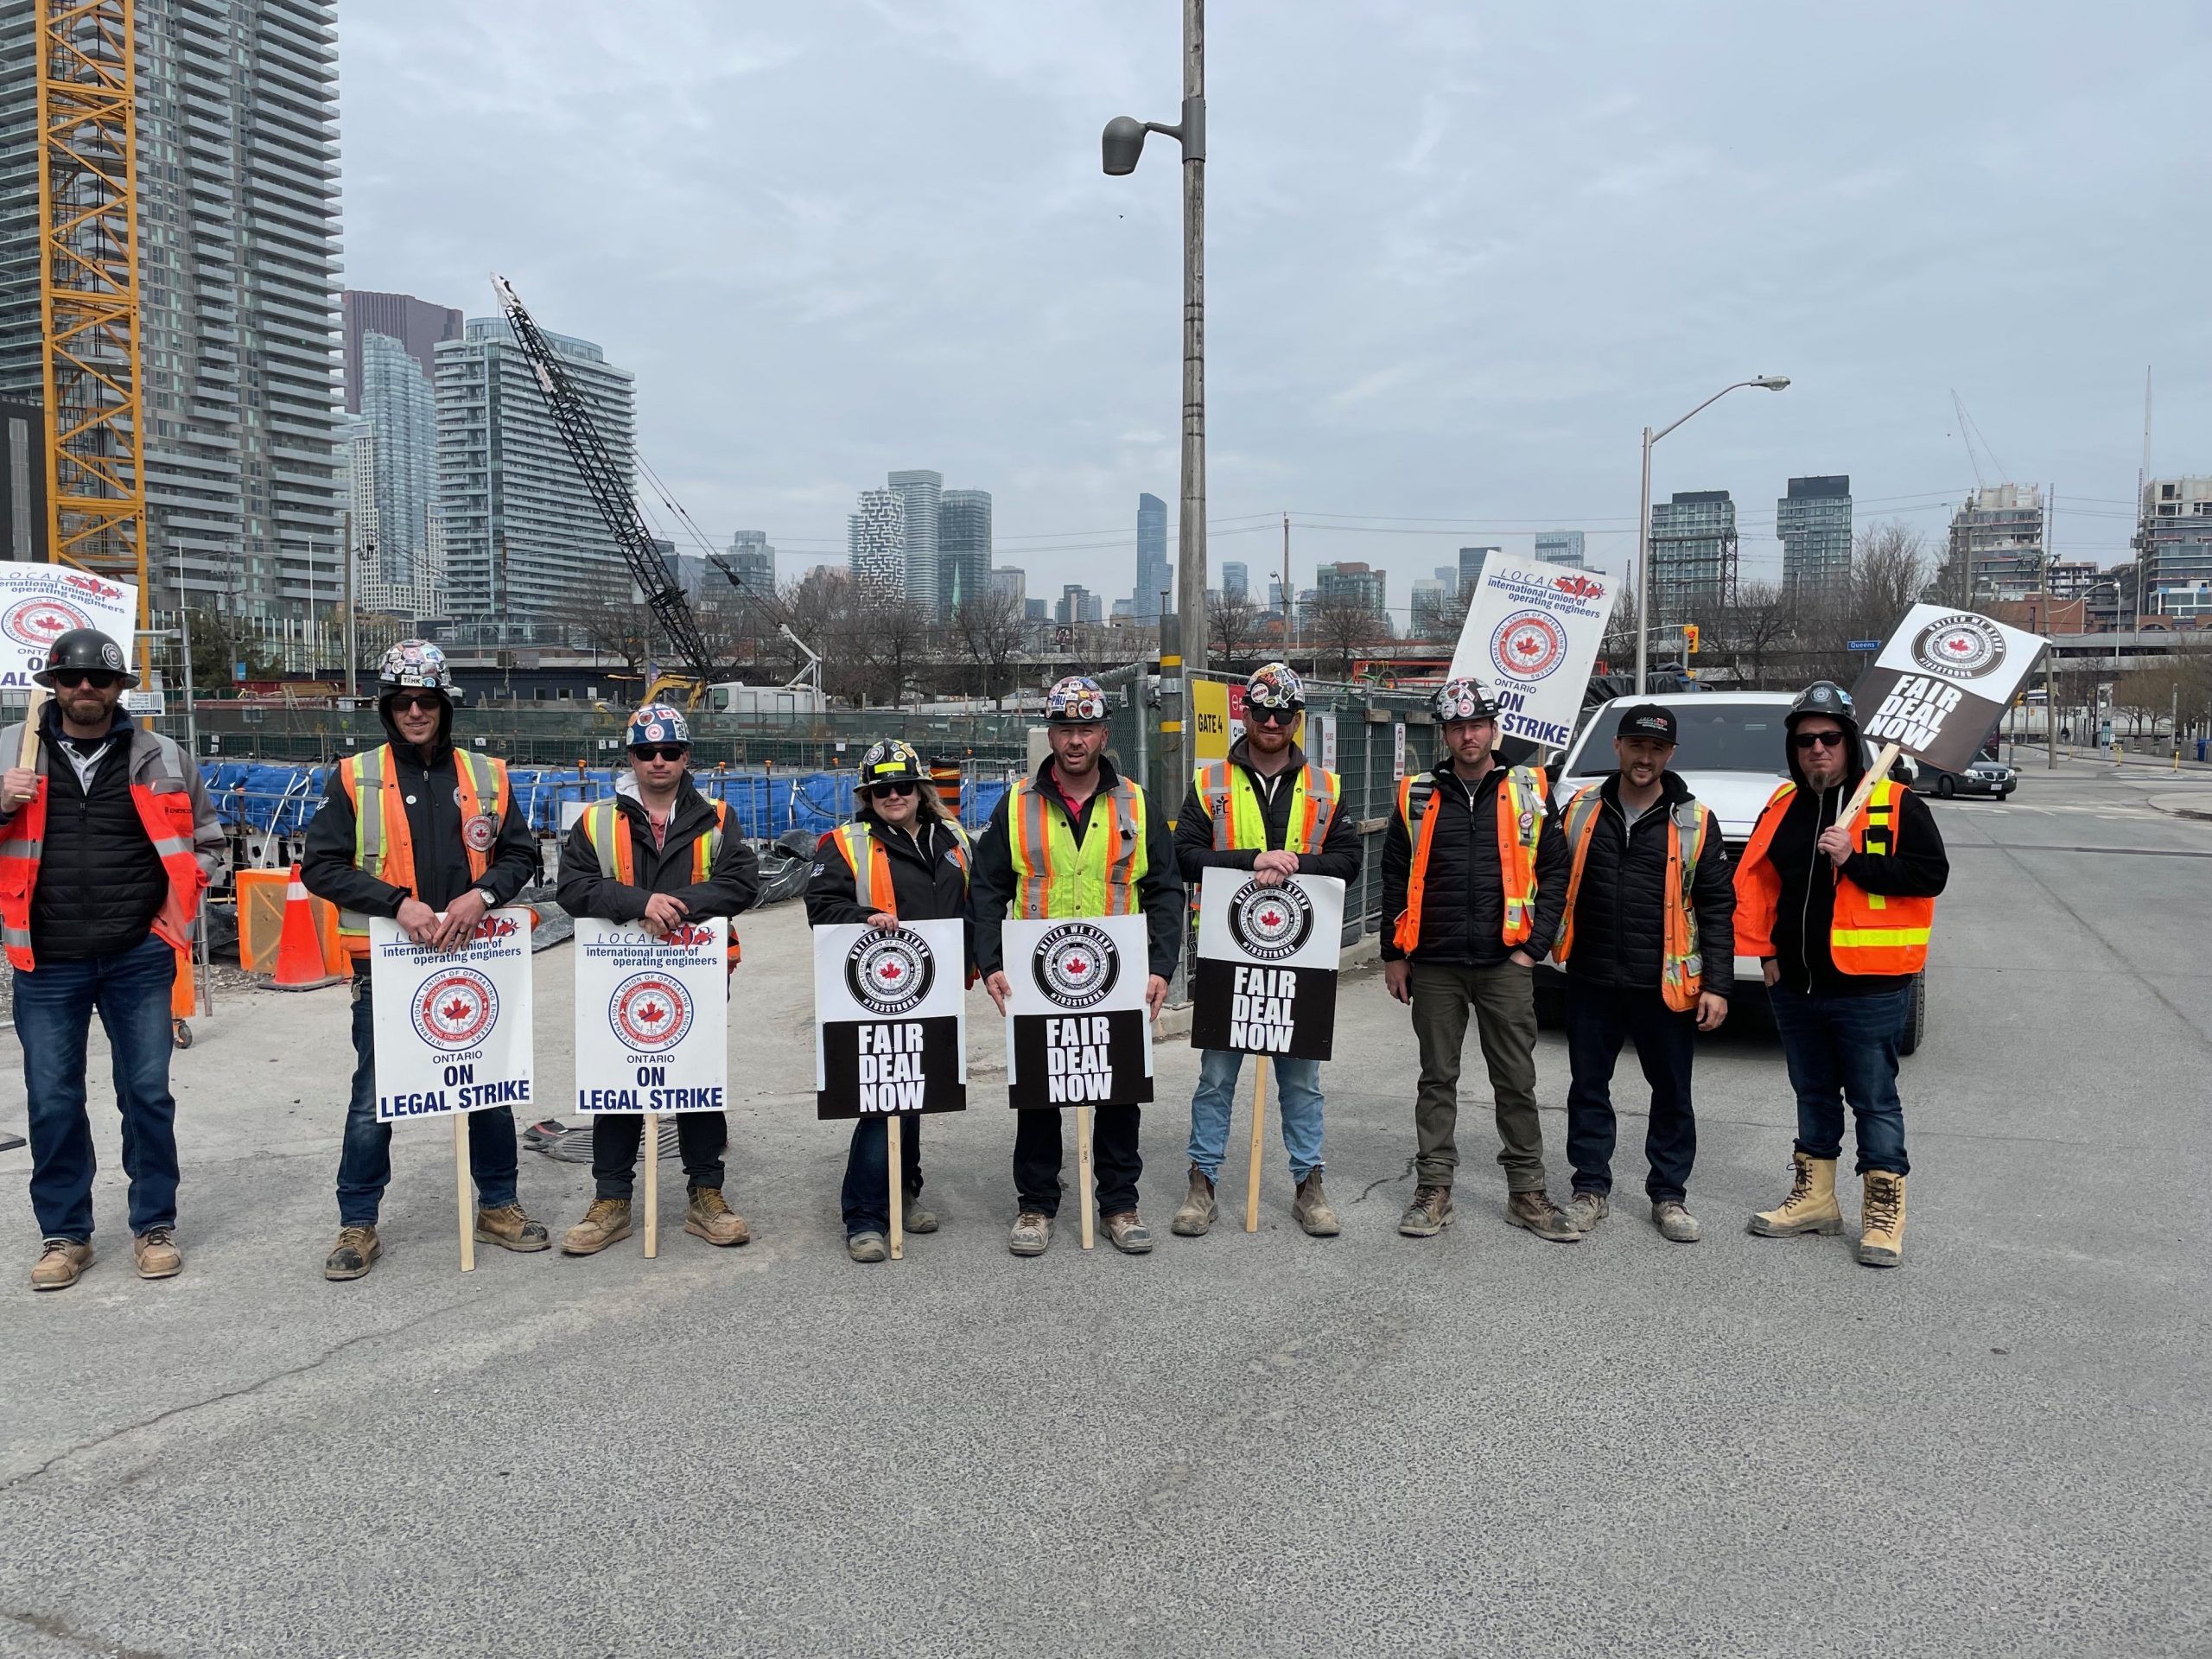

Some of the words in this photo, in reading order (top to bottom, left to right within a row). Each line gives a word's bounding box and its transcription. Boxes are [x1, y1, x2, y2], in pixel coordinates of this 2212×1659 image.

[0, 579, 58, 592] ernational
[60, 585, 92, 597] union
[1500, 569, 1554, 588] LOCAL
[11, 587, 68, 599] operating
[71, 594, 125, 614] engineers
[1488, 578, 1547, 598] international
[1548, 593, 1575, 605] union
[1576, 598, 1587, 607] of
[1509, 593, 1553, 609] operating
[1554, 602, 1600, 619] engineers
[1928, 616, 1966, 632] UNITED
[1971, 616, 1986, 626] WE
[1493, 625, 1509, 673] INTERNATIONAL
[1508, 613, 1529, 624] UNION
[1542, 615, 1565, 650] OPERATING
[1918, 657, 1972, 677] #793STRONG
[1494, 678, 1537, 694] ONTARIO
[1890, 675, 1963, 713] FAIR
[1498, 690, 1525, 713] ON
[1877, 695, 1942, 734] DEAL
[1198, 714, 1217, 734] GATE
[1217, 715, 1223, 734] 4
[1502, 713, 1570, 746] STRIKE
[1863, 715, 1939, 753] NOW
[1211, 799, 1229, 816] GFL
[1234, 882, 1259, 905] UNITE
[1286, 884, 1310, 911] STAND
[1249, 891, 1267, 902] UNION
[492, 938, 502, 949] of
[597, 932, 658, 944] LOCAL
[849, 931, 881, 961] UNITED
[903, 932, 931, 958] STAND
[866, 942, 883, 956] UNION
[1036, 928, 1066, 956] UNITED
[1071, 925, 1084, 934] WE
[1088, 928, 1115, 953] STAND
[1052, 938, 1069, 952] UNION
[1080, 937, 1106, 961] OPERATING
[1242, 941, 1296, 958] #793STRONG
[413, 952, 468, 966] operating
[470, 947, 522, 962] engineers
[587, 947, 653, 957] international
[656, 948, 685, 957] union
[688, 946, 699, 957] of
[613, 957, 664, 969] operating
[665, 957, 717, 969] engineers
[895, 941, 922, 967] OPERATING
[423, 973, 447, 993] UNION
[462, 970, 496, 1001] OPERATING
[620, 976, 642, 993] UNION
[858, 957, 881, 999] INTERNATIONAL
[900, 968, 922, 998] ENGINEERS
[1046, 953, 1068, 994] INTERNATIONAL
[1234, 966, 1296, 998] FAIR
[658, 976, 691, 1008] OPERATING
[862, 995, 919, 1013] #793STRONG
[1050, 989, 1106, 1007] #793STRONG
[414, 995, 445, 1047] INTERNATIONAL
[471, 1003, 498, 1044] ENGINEERS
[612, 995, 639, 1048] INTERNATIONAL
[1231, 994, 1294, 1027] DEAL
[664, 1010, 691, 1048] ENGINEERS
[859, 1023, 924, 1054] FAIR
[1046, 1016, 1110, 1047] FAIR
[1230, 1021, 1294, 1052] NOW
[432, 1050, 483, 1065] ONTARIO
[626, 1054, 675, 1064] ONTARIO
[859, 1052, 925, 1084] DEAL
[1046, 1045, 1112, 1076] DEAL
[443, 1064, 474, 1087] ON
[637, 1066, 665, 1087] ON
[1048, 1072, 1112, 1103] NOW
[381, 1090, 451, 1118] LEGAL
[459, 1080, 530, 1109] STRIKE
[579, 1090, 643, 1110] LEGAL
[650, 1087, 723, 1110] STRIKE
[859, 1081, 925, 1112] NOW
